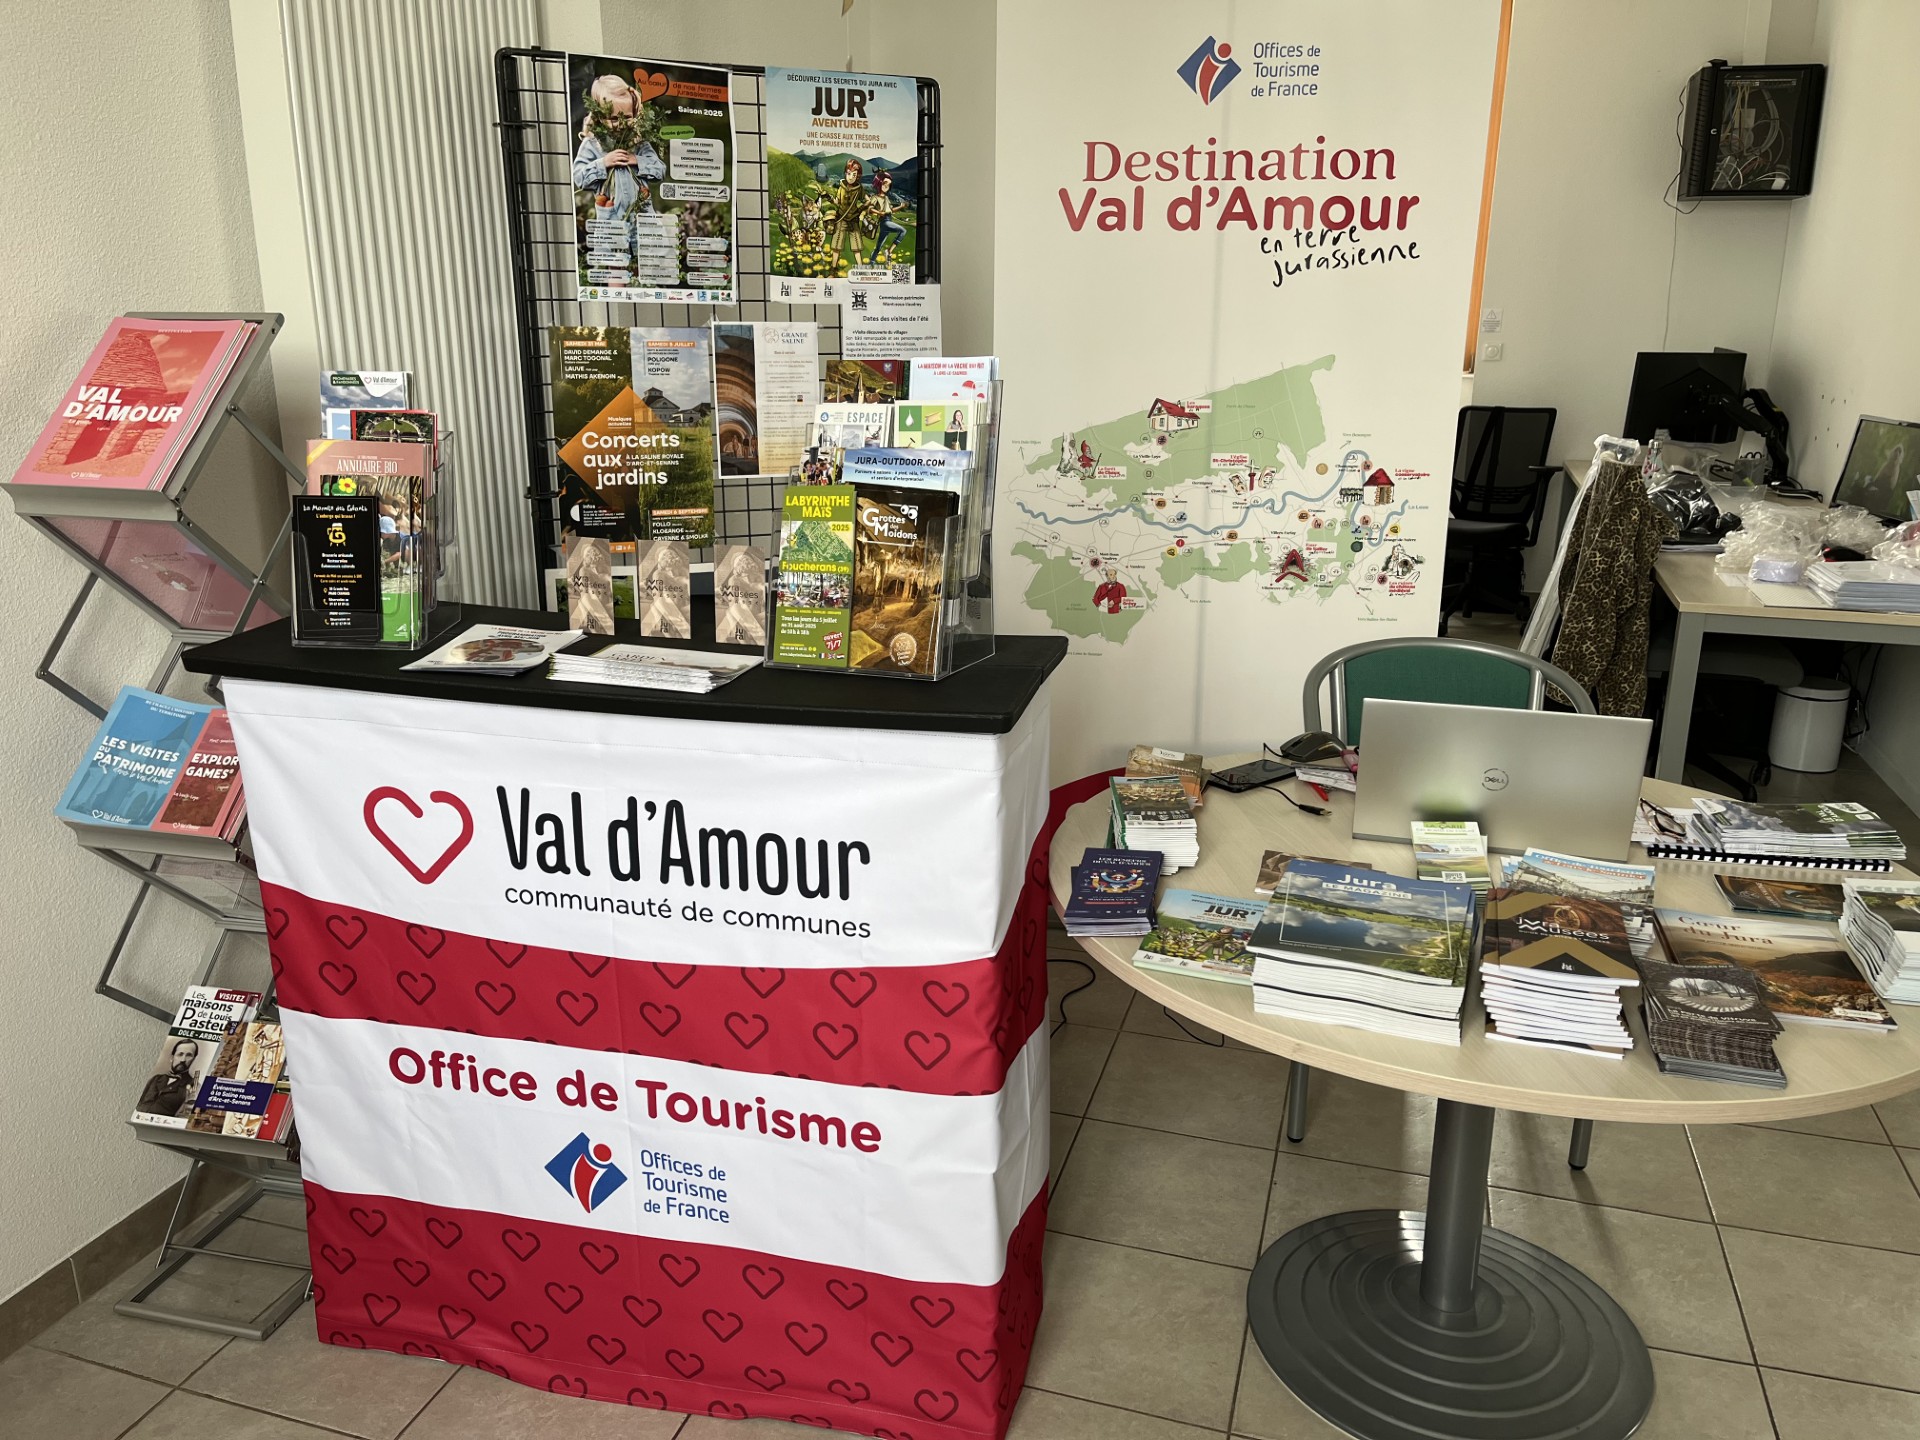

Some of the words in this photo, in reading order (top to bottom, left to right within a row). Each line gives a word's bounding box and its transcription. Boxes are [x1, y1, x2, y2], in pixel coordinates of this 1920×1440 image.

[1254, 42, 1303, 59] Offices
[1307, 45, 1321, 57] de
[1254, 62, 1319, 78] Tourisme
[787, 74, 820, 83] DÉCOUVREZ
[822, 76, 832, 84] LES
[832, 77, 858, 85] SECRETS
[868, 80, 882, 88] JURA
[1251, 85, 1264, 97] de
[1268, 81, 1318, 97] France
[677, 89, 719, 100] jurassiennes
[698, 85, 721, 94] fermes
[678, 106, 702, 115] Saison
[812, 87, 875, 118] JUR'
[812, 118, 868, 129] AVENTURES
[816, 140, 845, 148] S'AMUSER
[855, 133, 880, 141] TRÉSORS
[1083, 135, 1396, 181] Destination
[1059, 186, 1144, 232] Val
[1167, 185, 1420, 231] d'Amour
[1261, 237, 1282, 254] en
[1294, 226, 1360, 249] terre
[1273, 241, 1420, 287] jurassienne
[78, 385, 122, 404] VAL
[63, 401, 183, 423] D'AMOUR
[847, 412, 884, 423] ESPACE
[582, 432, 680, 449] Concerts
[337, 459, 382, 473] ANNUAIRE
[385, 462, 397, 473] BIO
[583, 454, 622, 467] aux
[854, 456, 945, 467] JURA-OUTDOOR.COM
[596, 469, 668, 490] jardins
[786, 496, 850, 507] LABYRINTHE
[863, 508, 906, 527] Grottes
[832, 524, 850, 532] 2025
[874, 523, 917, 540] Moidons
[782, 561, 836, 572] Foucherans
[824, 632, 842, 640] ouvert
[99, 745, 111, 753] DU
[102, 735, 128, 750] LES
[130, 743, 180, 762] VISITES
[93, 752, 176, 779] PATRIMOINE
[111, 813, 131, 824] d'Amour
[496, 784, 591, 877] Val
[607, 795, 871, 901] d'Amour
[1337, 874, 1397, 890] Jura
[1339, 884, 1411, 899] MAGAZINE
[504, 884, 672, 920] communauté
[680, 892, 714, 924] de
[722, 906, 871, 939] communes
[1204, 905, 1257, 919] JUR'
[1519, 924, 1610, 940] Musées
[1683, 926, 1716, 935] du
[1723, 932, 1773, 945] Jura
[192, 991, 205, 1000] Les
[219, 992, 246, 1002] VISITEZ
[182, 998, 234, 1013] maisons
[179, 1007, 228, 1032] Pasteu
[197, 1010, 208, 1019] de
[209, 1011, 232, 1022] Louis
[199, 1033, 223, 1041] ARBOIS
[388, 1046, 538, 1101] Office
[555, 1069, 619, 1112] de
[634, 1079, 883, 1153] Tourisme
[640, 1149, 704, 1180] Offices
[708, 1165, 727, 1181] de
[642, 1171, 728, 1203] Tourisme
[643, 1199, 661, 1214] de
[665, 1198, 730, 1224] France
